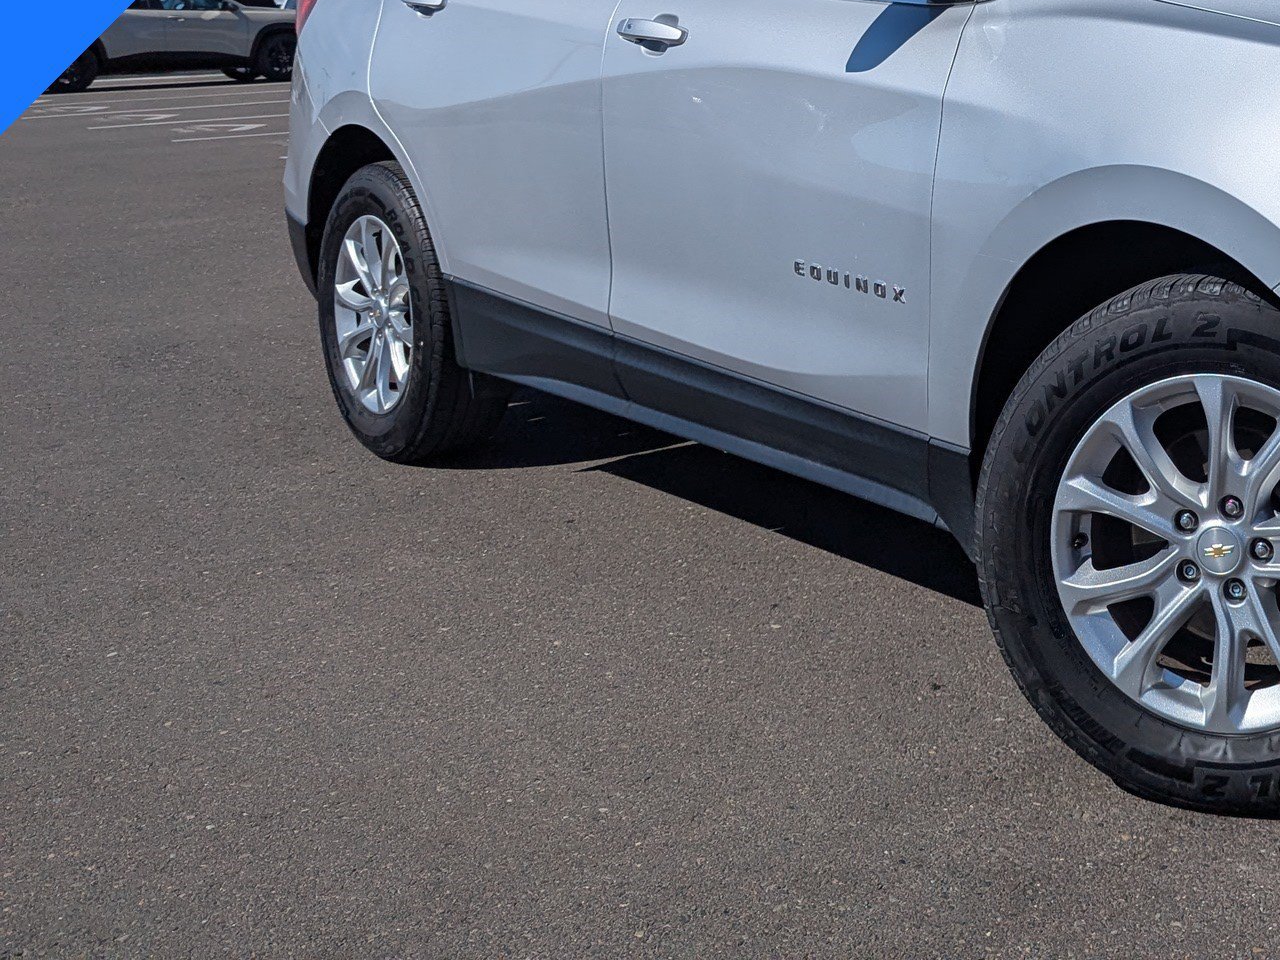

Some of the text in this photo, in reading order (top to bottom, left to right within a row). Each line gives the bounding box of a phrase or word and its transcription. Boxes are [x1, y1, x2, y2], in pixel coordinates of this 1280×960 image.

[793, 258, 907, 304] EQUINOX
[1010, 311, 1223, 464] CONTROL 2
